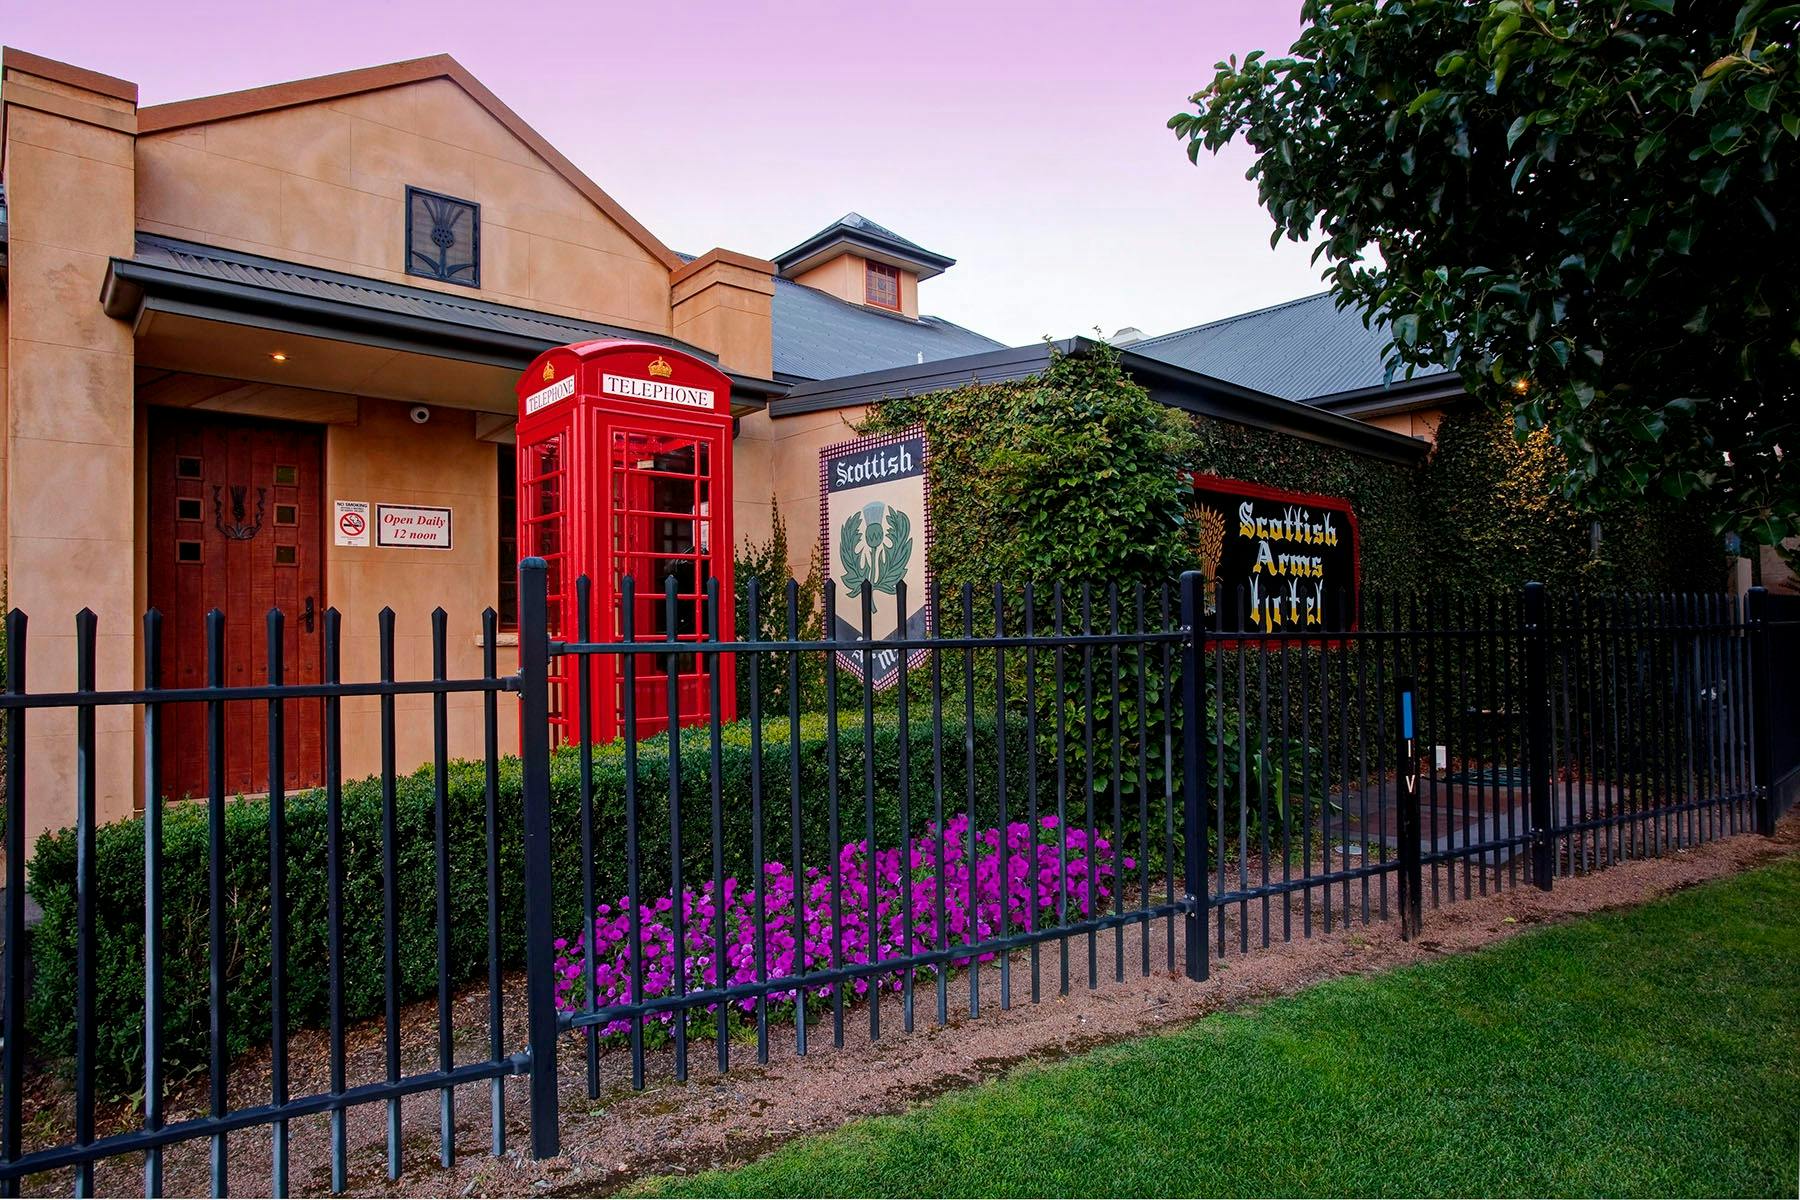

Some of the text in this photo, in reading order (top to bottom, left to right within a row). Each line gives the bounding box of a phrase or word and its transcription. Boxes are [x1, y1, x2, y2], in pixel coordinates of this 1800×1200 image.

[528, 378, 574, 412] TELEPHONE
[608, 376, 708, 407] TELEPHONE
[836, 444, 914, 487] Scottish
[384, 513, 446, 529] Open Daily
[393, 529, 437, 540] 12 noon
[1238, 501, 1339, 547] Scottish
[1252, 540, 1324, 577] Arms
